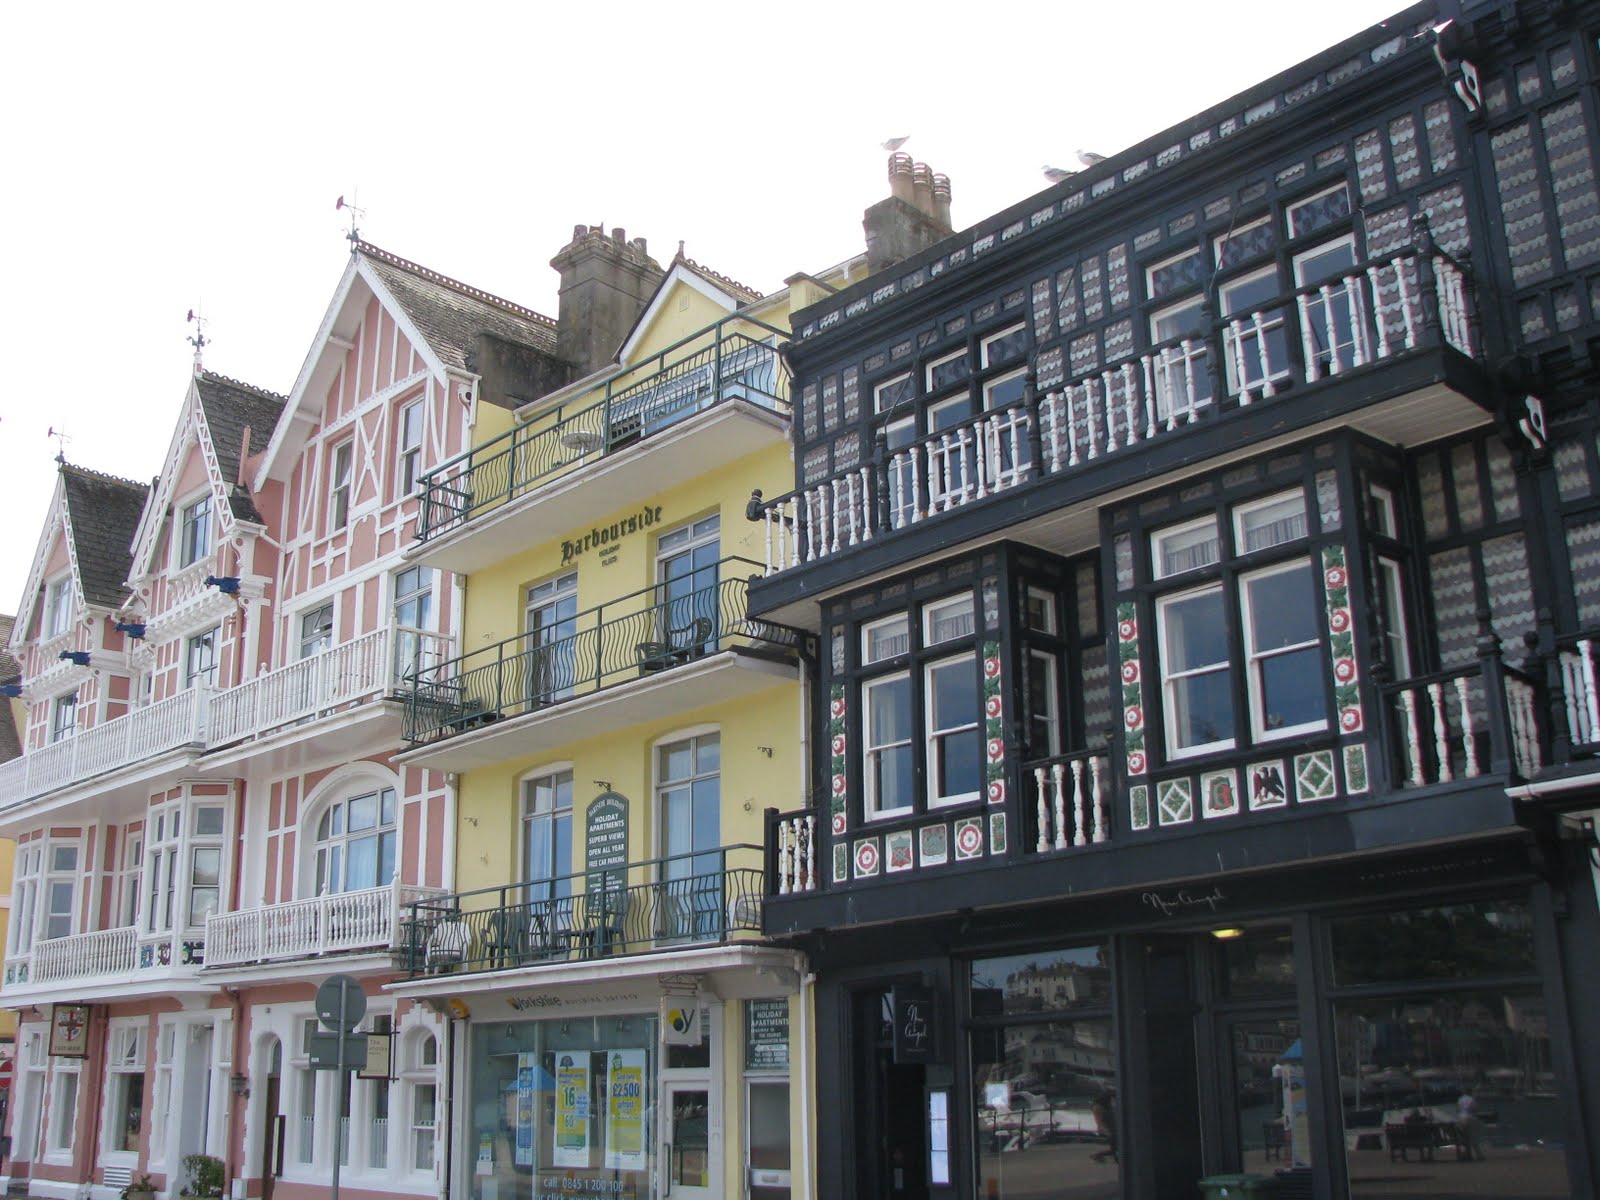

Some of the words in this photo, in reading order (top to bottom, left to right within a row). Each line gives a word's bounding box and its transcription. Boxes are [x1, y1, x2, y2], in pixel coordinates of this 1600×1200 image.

[560, 505, 662, 567] Harbourside
[594, 813, 620, 824] HOLIDAY
[589, 819, 625, 833] APARTMENTS
[588, 834, 608, 845] SUPERB
[608, 831, 625, 841] VIEWS
[588, 847, 601, 857] OPEN
[602, 845, 611, 854] ALL
[611, 843, 625, 853] YEAR
[588, 859, 598, 868] FREE
[598, 858, 607, 866] CAR
[607, 855, 625, 865] PARKING
[751, 1018, 789, 1026] APARTMENTS
[543, 1176, 558, 1188] call
[562, 1178, 582, 1190] 0845
[591, 1179, 606, 1191] 200
[609, 1180, 624, 1192] 100
